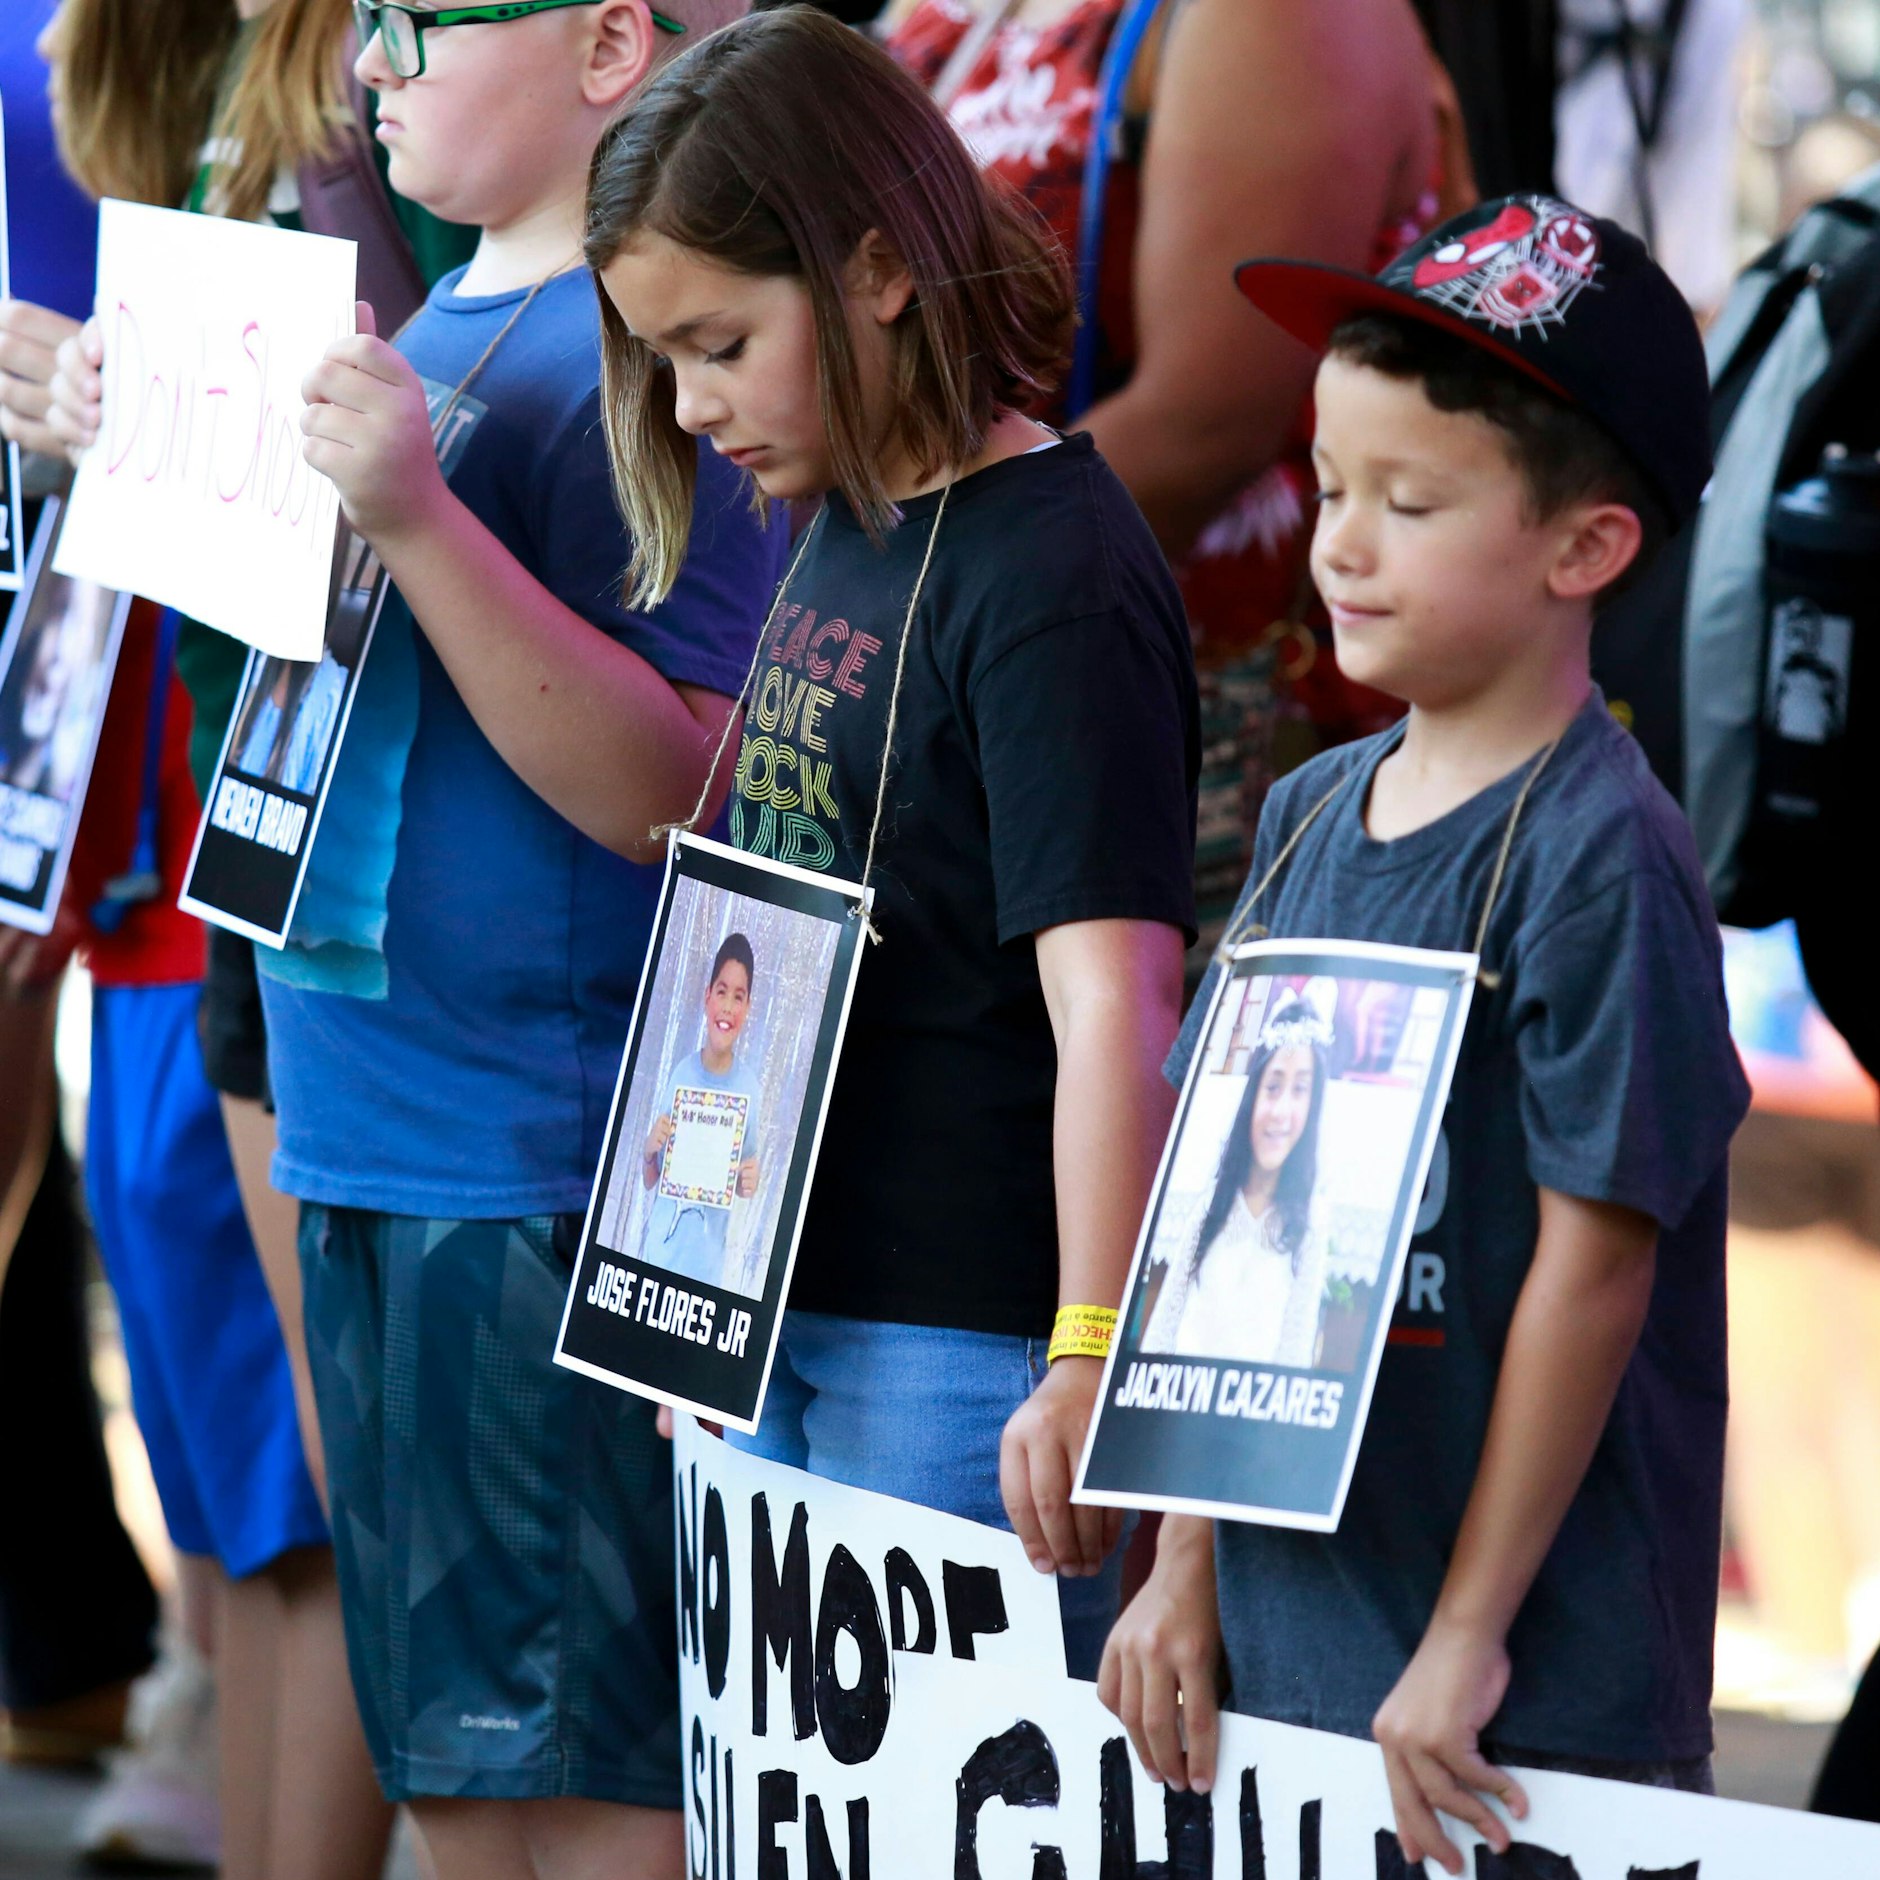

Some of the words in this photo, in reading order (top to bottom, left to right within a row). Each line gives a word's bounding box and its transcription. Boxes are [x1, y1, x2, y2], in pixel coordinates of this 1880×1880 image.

[255, 792, 309, 857] BRAVO
[697, 1110, 718, 1126] Honor
[720, 1114, 734, 1128] Roll
[586, 1261, 638, 1318] JOSE
[635, 1277, 717, 1346] FLORES
[716, 1308, 752, 1358] JR
[1071, 1324, 1114, 1341] HECK
[1114, 1361, 1218, 1414] JACKLYN
[1215, 1368, 1345, 1429] CAZARES
[678, 1460, 731, 1700] NO
